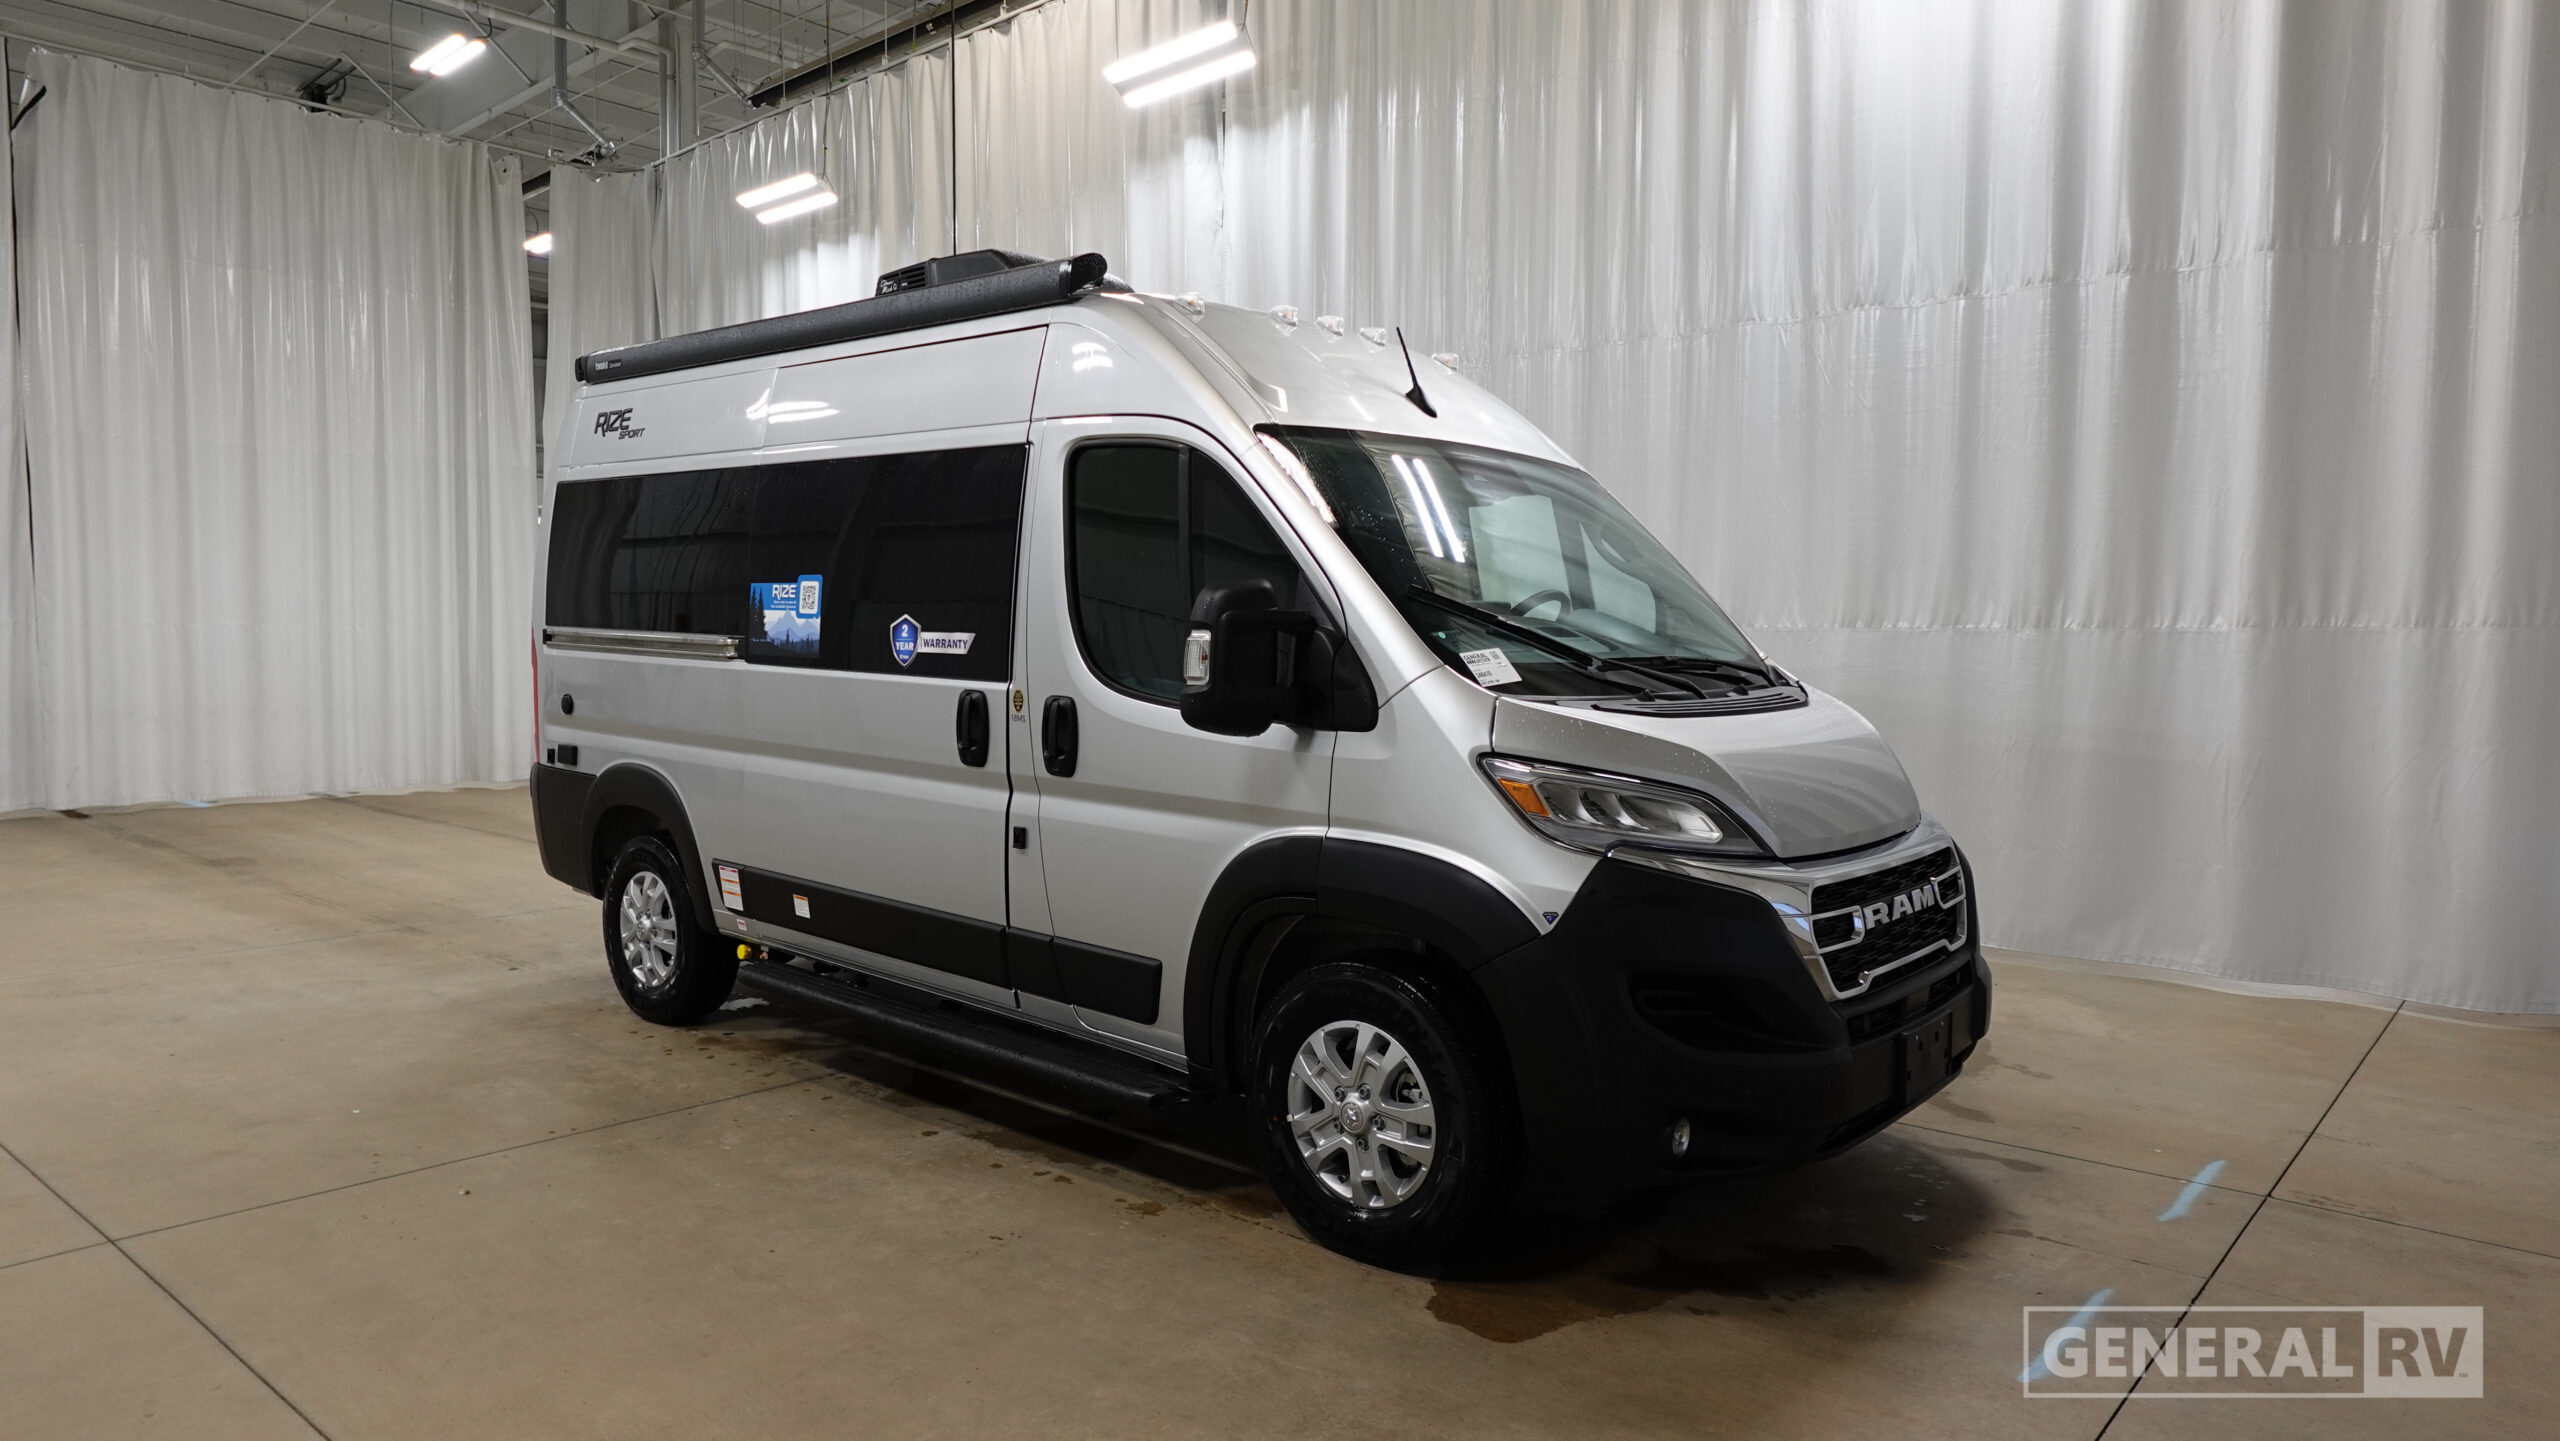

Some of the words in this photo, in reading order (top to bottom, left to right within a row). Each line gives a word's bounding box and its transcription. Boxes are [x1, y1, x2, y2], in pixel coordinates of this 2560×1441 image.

[594, 408, 633, 437] RIZE
[618, 428, 645, 439] SPORT
[772, 584, 797, 600] RIZE
[901, 624, 909, 637] 2
[895, 642, 914, 651] YEAR
[923, 638, 968, 649] WARRANTY
[1863, 885, 1935, 929] RAM
